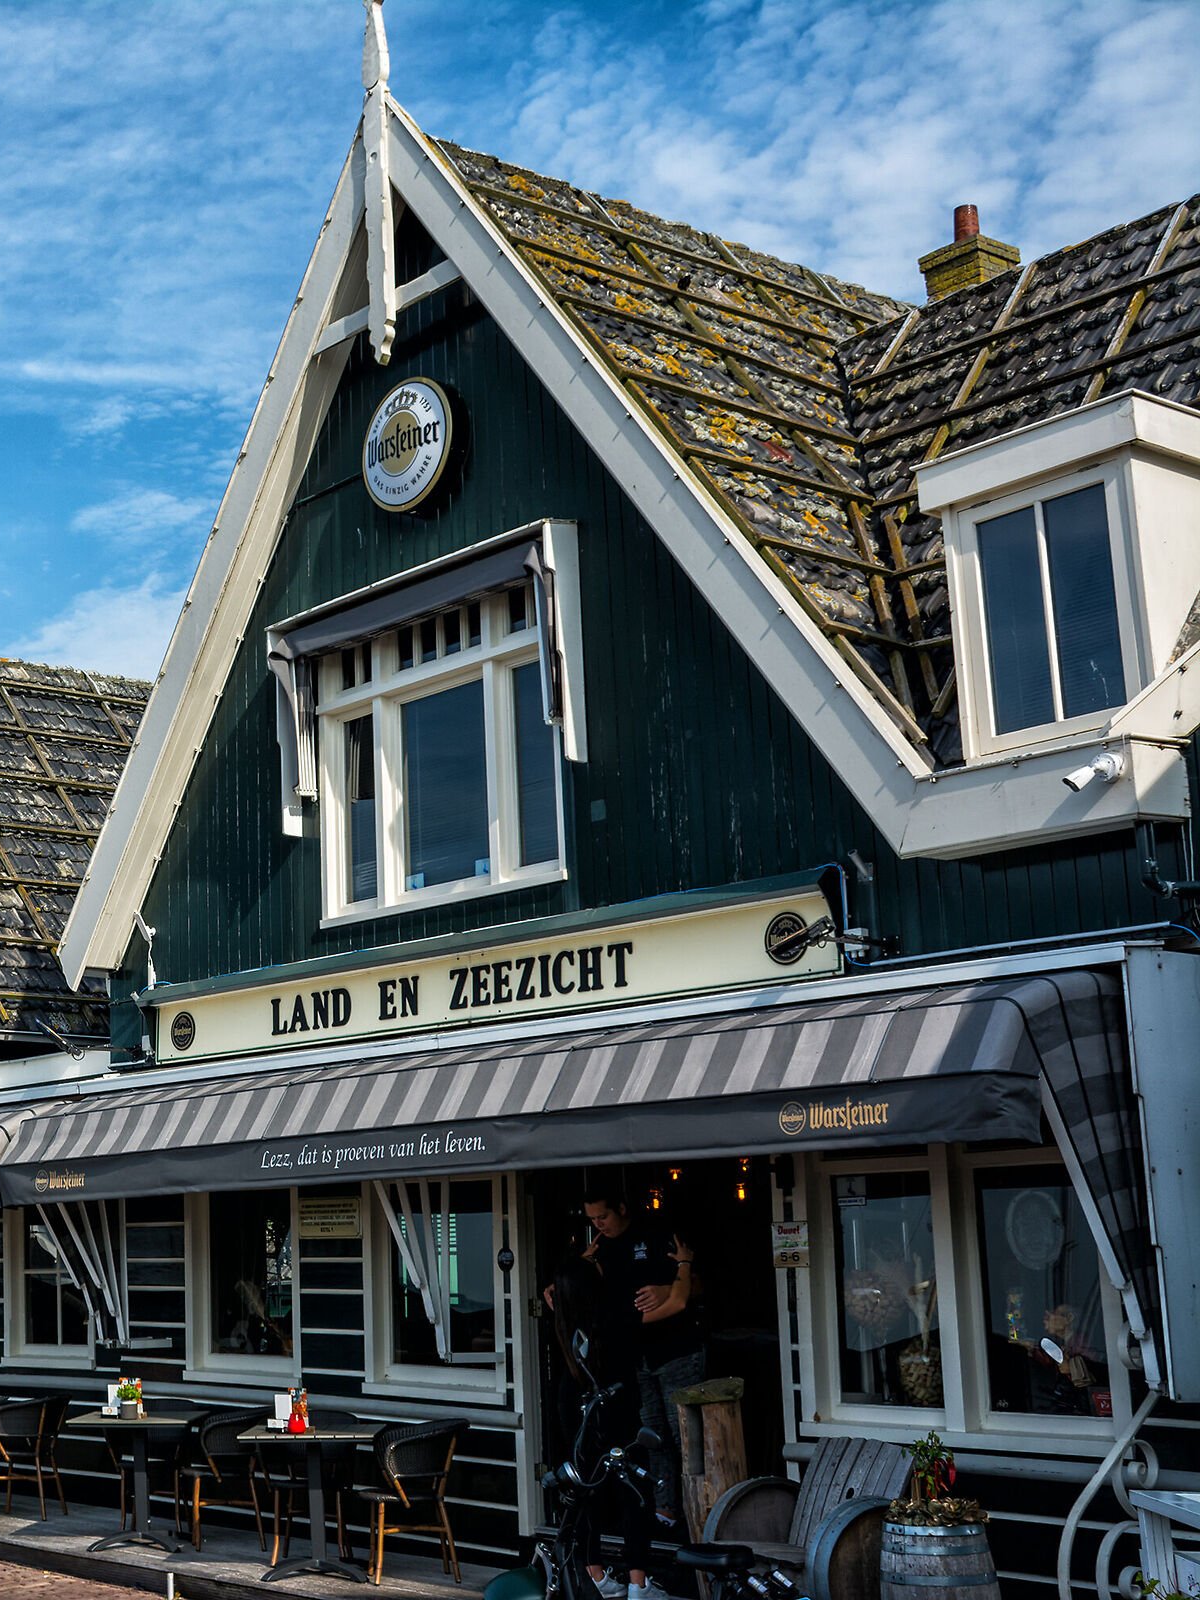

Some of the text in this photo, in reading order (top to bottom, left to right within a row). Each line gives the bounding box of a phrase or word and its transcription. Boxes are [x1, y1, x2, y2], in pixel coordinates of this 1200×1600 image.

[368, 420, 440, 469] Warsteiner
[373, 454, 432, 495] DAS EINZIG WAHRE
[271, 942, 633, 1036] LAND EN ZEEZICHT
[809, 1097, 889, 1131] Warsteiner
[261, 1131, 486, 1169] Lezz, dat is proeven van het leven.
[49, 1170, 86, 1191] Warsteiner
[780, 1251, 800, 1262] 5-6
